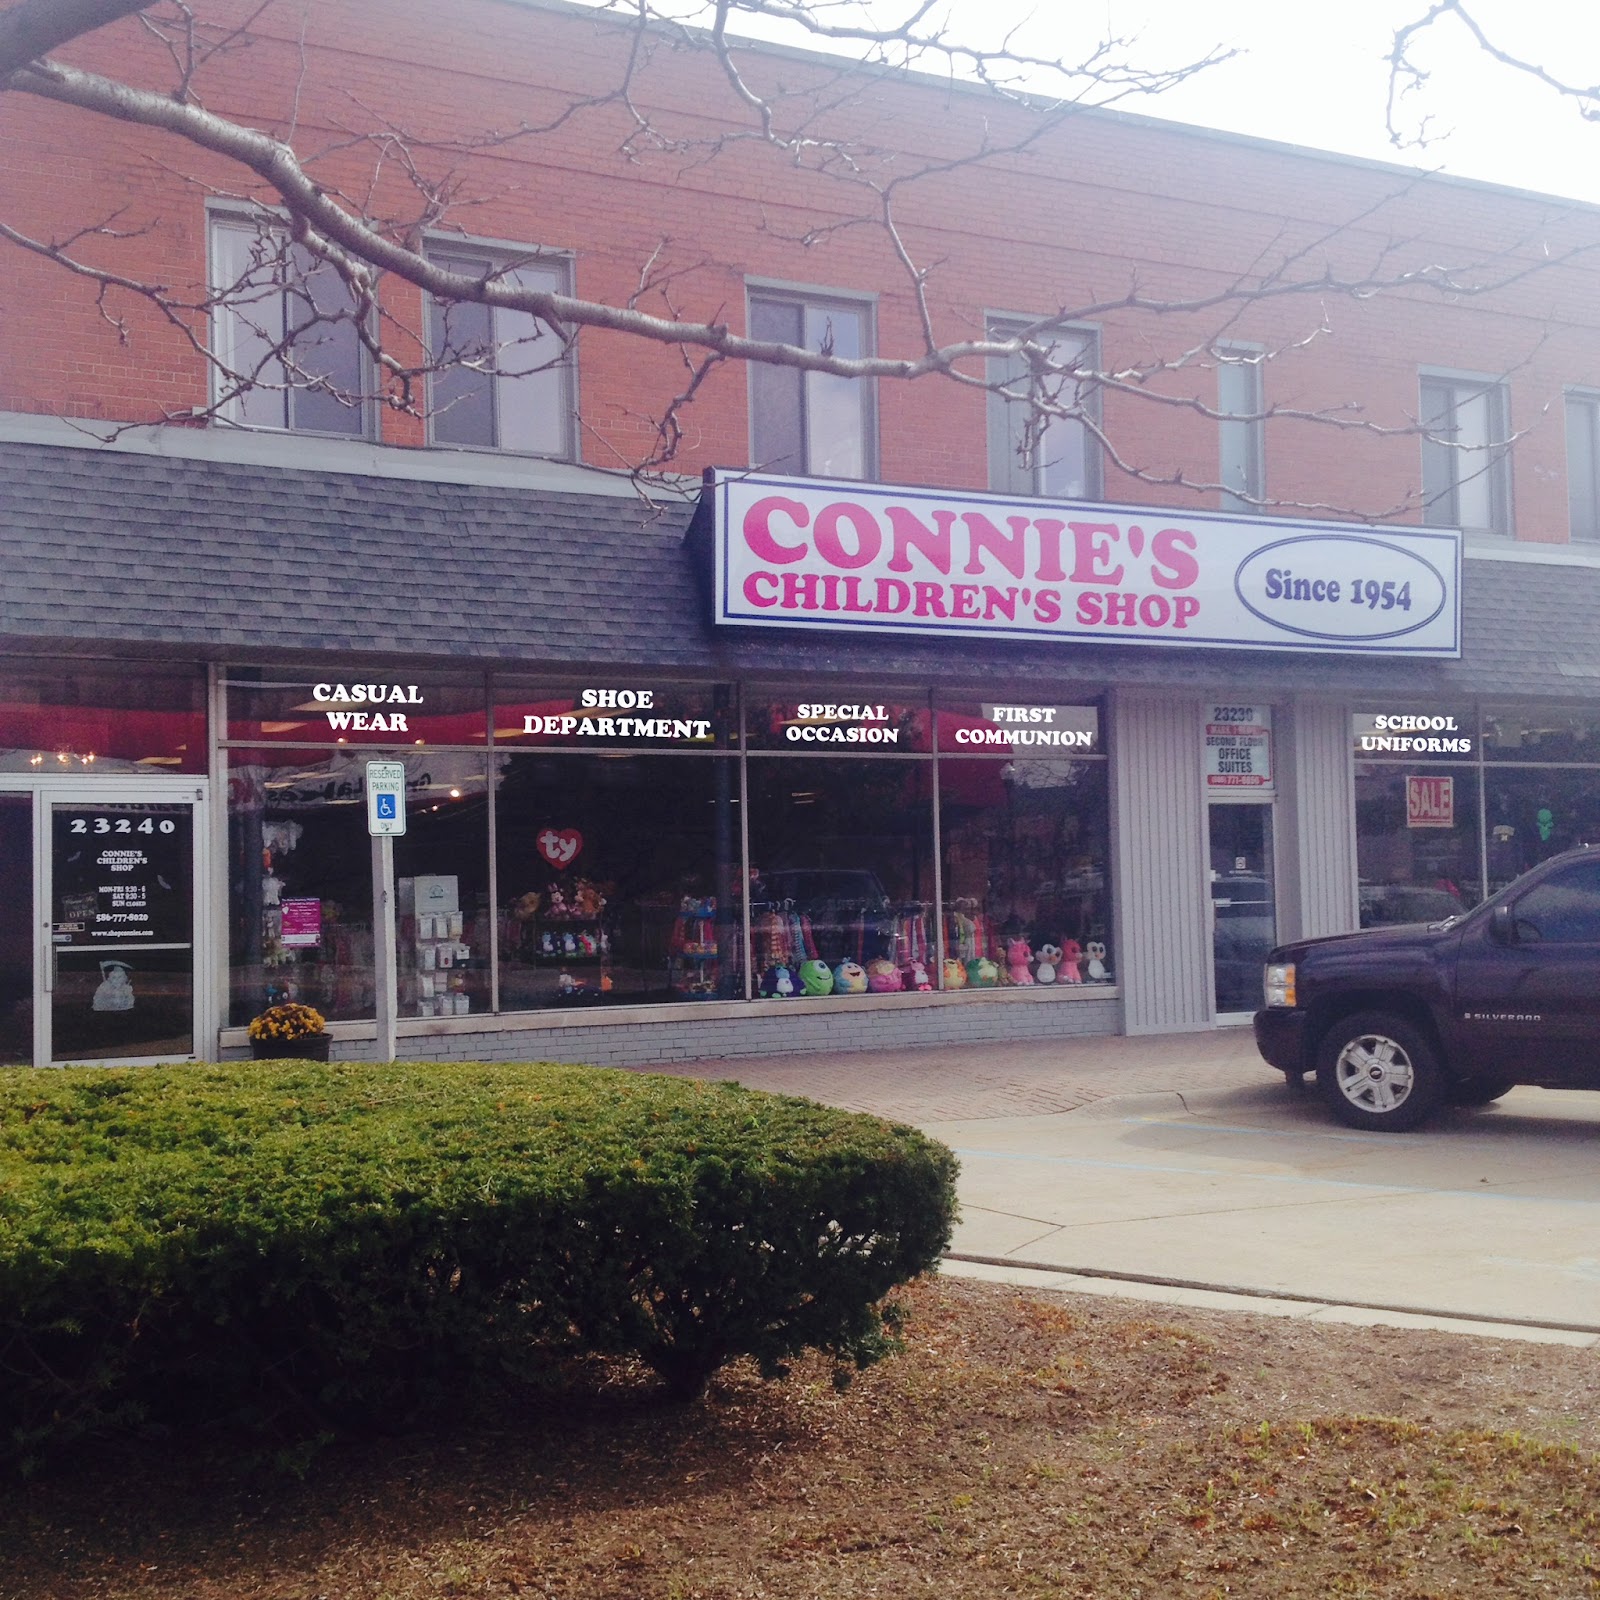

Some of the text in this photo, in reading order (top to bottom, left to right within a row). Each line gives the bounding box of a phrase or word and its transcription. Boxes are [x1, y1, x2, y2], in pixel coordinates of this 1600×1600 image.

[743, 495, 1200, 590] CONNIE'S
[1264, 567, 1412, 611] Since 1954
[742, 571, 1201, 630] CHILDREN'S SHOP
[312, 683, 424, 705] CASUAL
[581, 689, 654, 710] SHOE
[797, 704, 889, 722] SPECIAL
[992, 707, 1057, 724] FIRST
[1214, 706, 1254, 722] 23230
[326, 712, 409, 733] WEAR
[523, 715, 711, 739] DEPARTMENT
[1374, 715, 1458, 731] SCHOOL
[785, 726, 900, 744] OCCASION
[954, 728, 1093, 747] COMMUNION
[1206, 736, 1264, 747] SECOND FLOOR
[1360, 736, 1472, 753] UNIFORMS
[1218, 747, 1251, 760] OFFICE
[369, 769, 401, 779] RESERVED
[1217, 761, 1253, 773] SUITES
[372, 782, 399, 791] PARKING
[1409, 780, 1451, 818] SALE
[70, 817, 176, 834] 23240
[380, 822, 393, 830] ONLY
[102, 850, 143, 858] CONNIE'S
[540, 831, 577, 862] ty
[96, 857, 148, 865] CHILDREN'S
[110, 864, 134, 872] SHOP
[95, 913, 149, 923] 586-777-8020
[1474, 1013, 1541, 1021] SILVERADO
